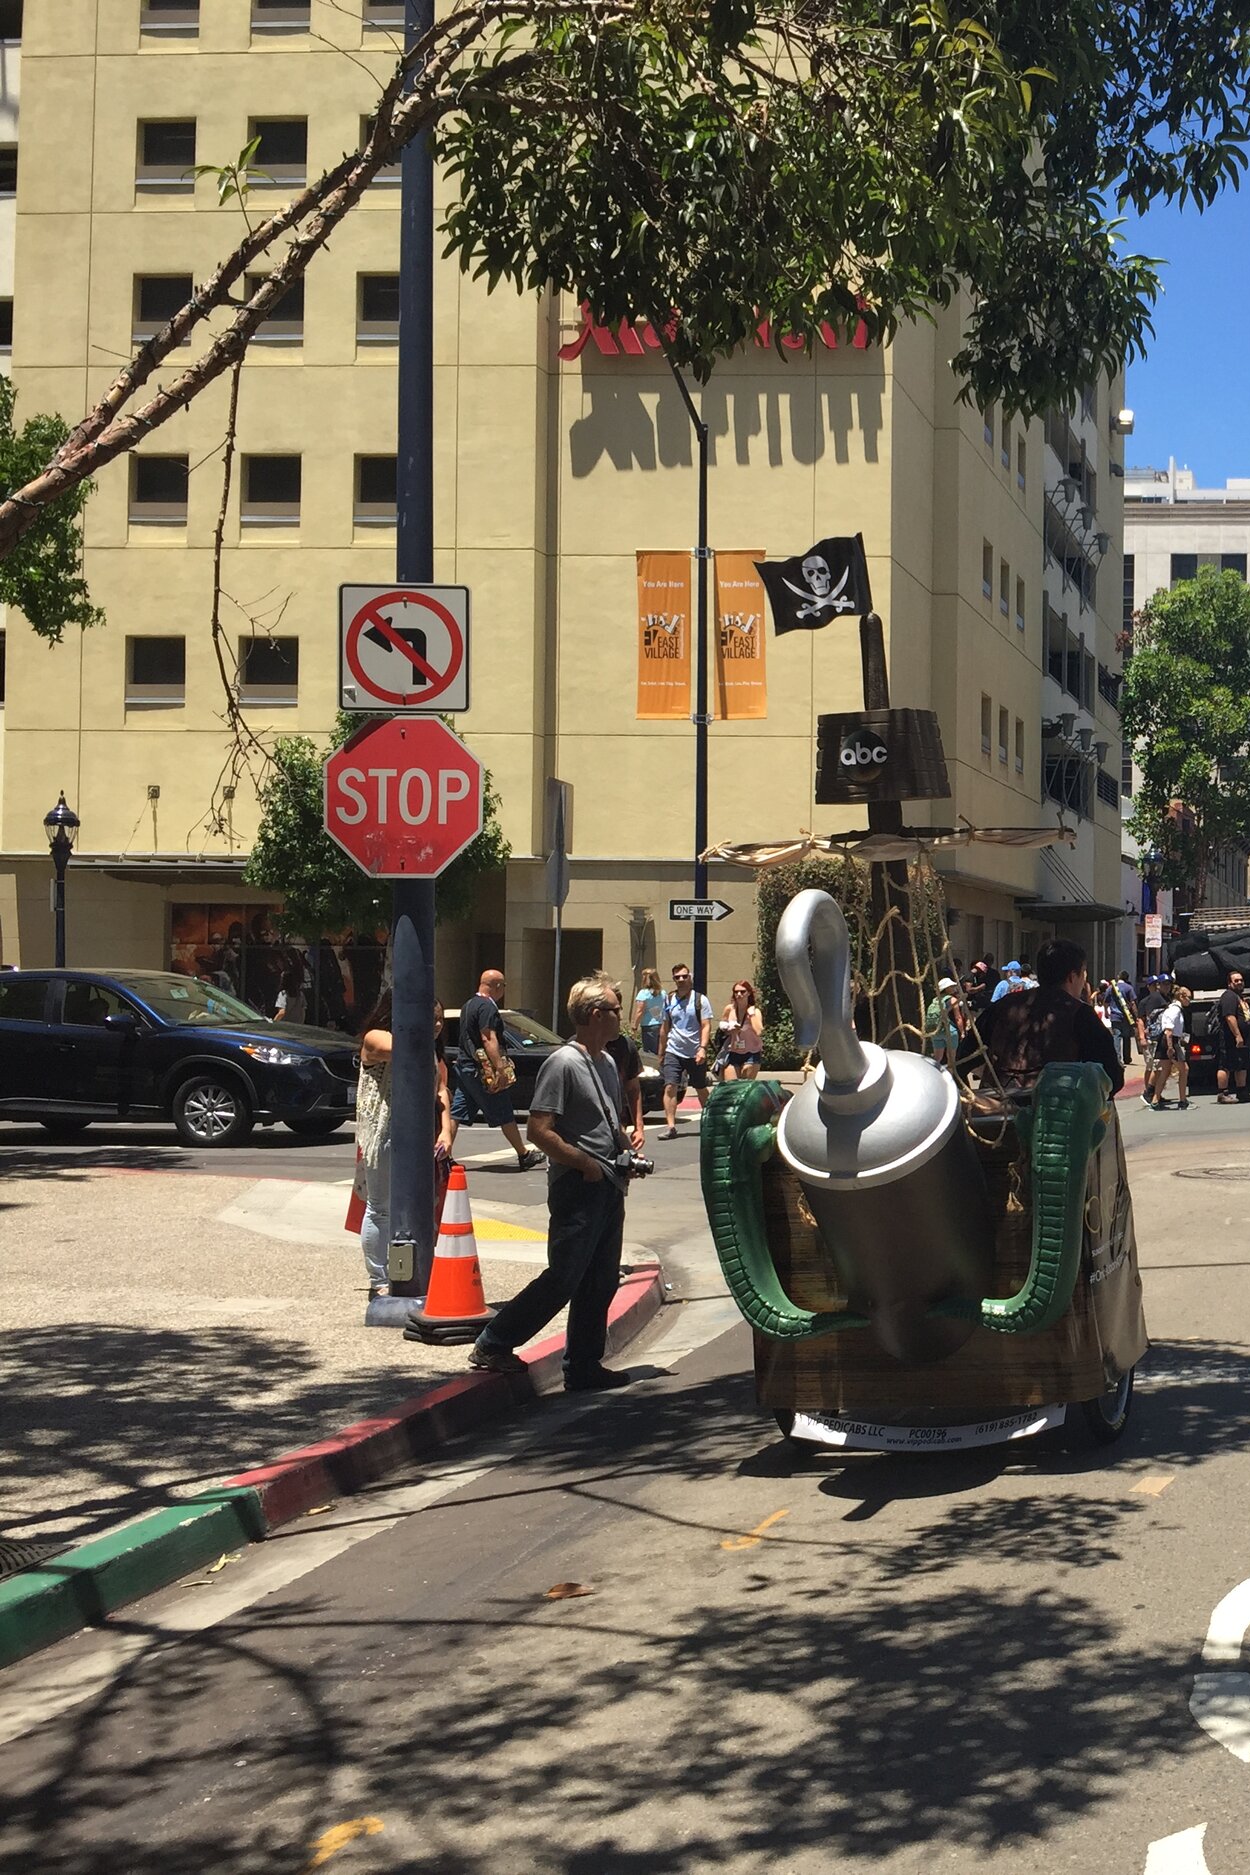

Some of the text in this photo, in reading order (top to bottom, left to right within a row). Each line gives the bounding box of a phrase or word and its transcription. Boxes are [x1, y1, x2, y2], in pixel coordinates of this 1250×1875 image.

[657, 636, 679, 648] EAST
[734, 636, 755, 648] EAST
[645, 647, 679, 659] VILLAGE
[721, 647, 756, 659] VILLAGE
[841, 742, 888, 766] abc
[336, 767, 471, 826] STOP
[676, 906, 714, 914] ONE WAY
[823, 1419, 867, 1434] PEDICABS
[868, 1426, 885, 1437] LLC
[909, 1428, 947, 1438] PC00196
[975, 1424, 997, 1435] (619)
[999, 1412, 1038, 1430] 885-1782
